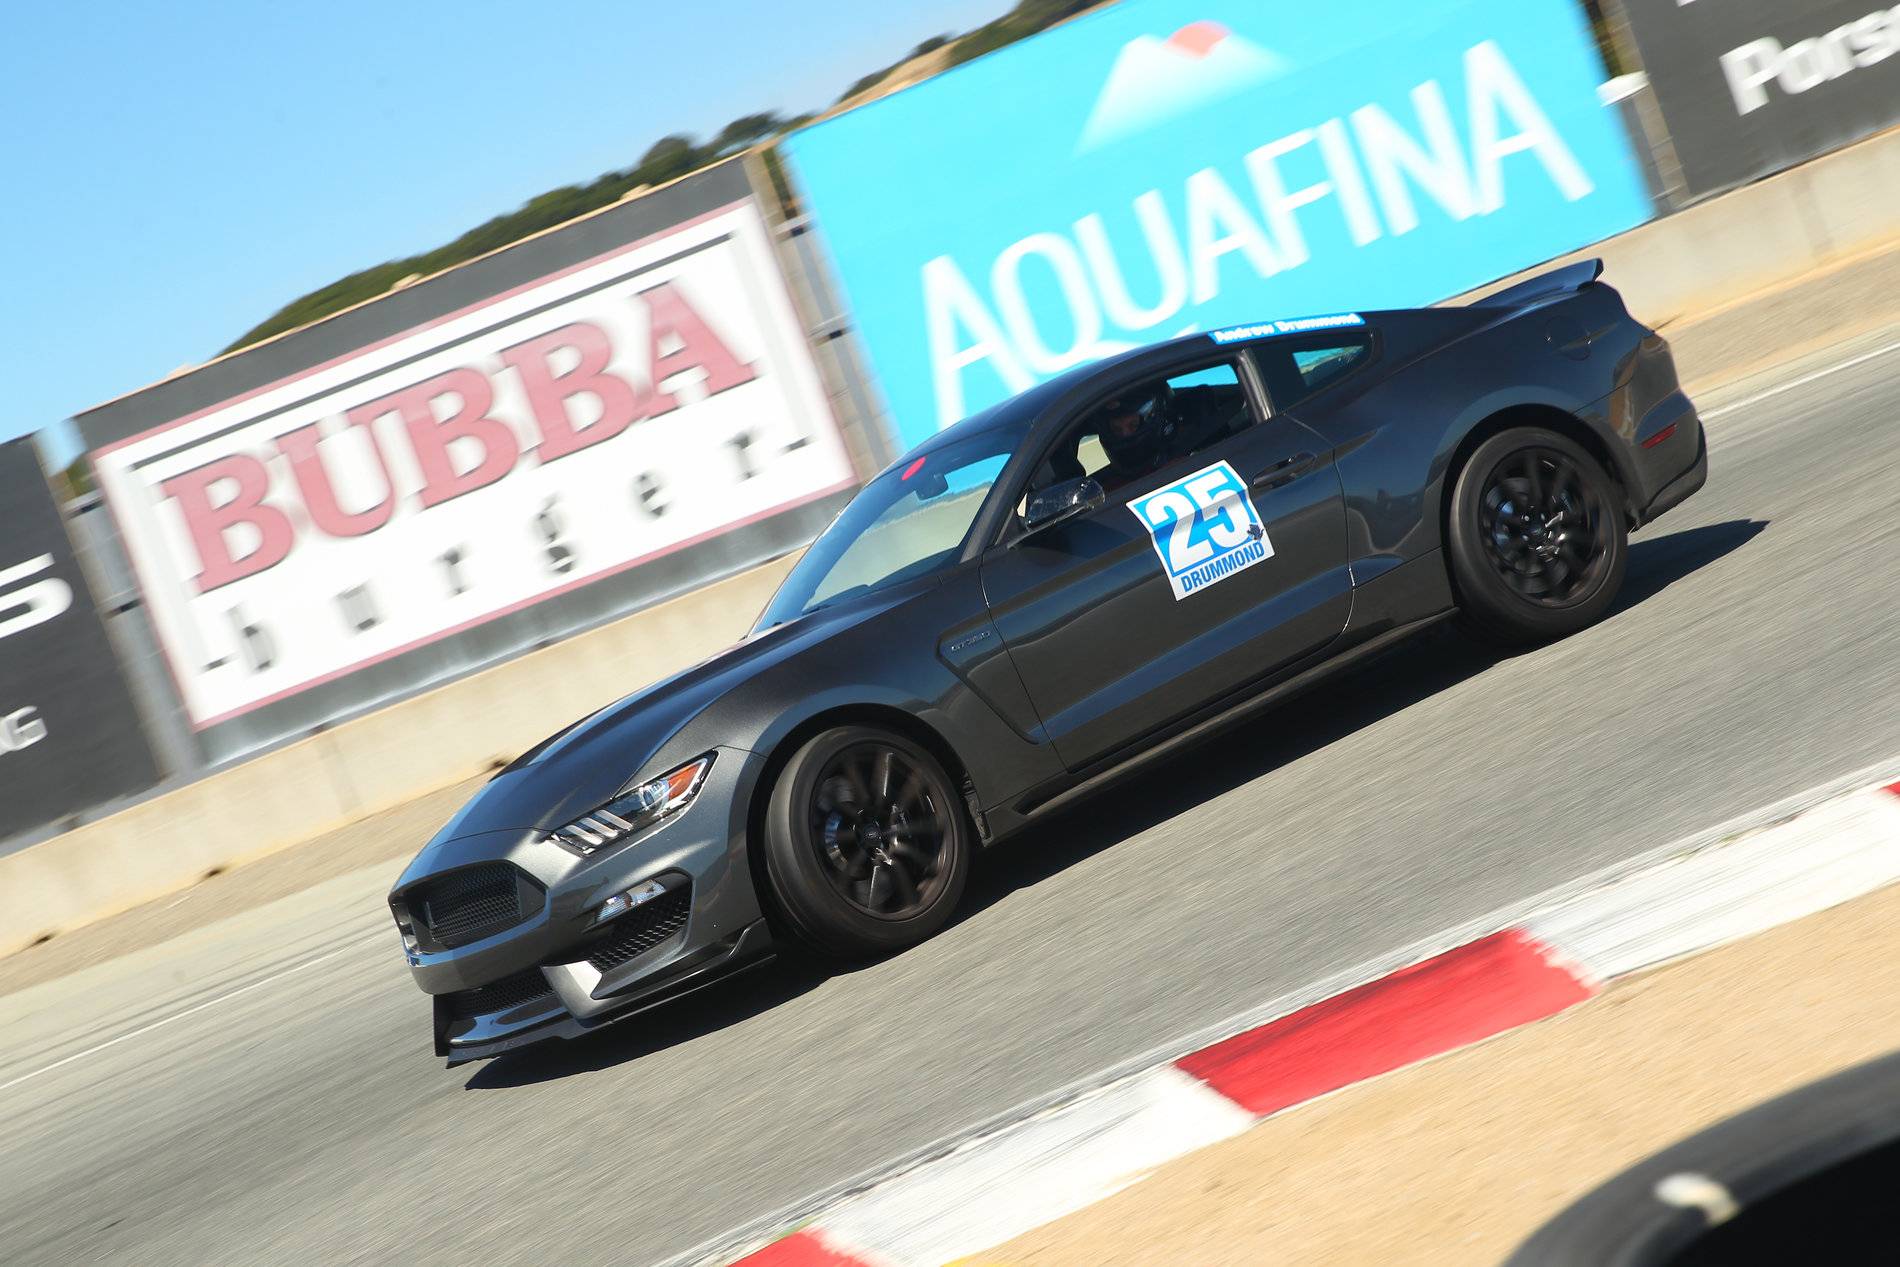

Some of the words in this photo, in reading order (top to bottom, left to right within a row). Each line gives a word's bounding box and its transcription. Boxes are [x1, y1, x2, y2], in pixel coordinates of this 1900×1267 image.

[1718, 3, 1900, 117] Pors
[919, 40, 1595, 431] AQUAFINA
[162, 280, 757, 594] BUBBA
[1145, 470, 1251, 572] 25
[224, 429, 764, 672] burger
[1180, 541, 1265, 592] DRUMMOND
